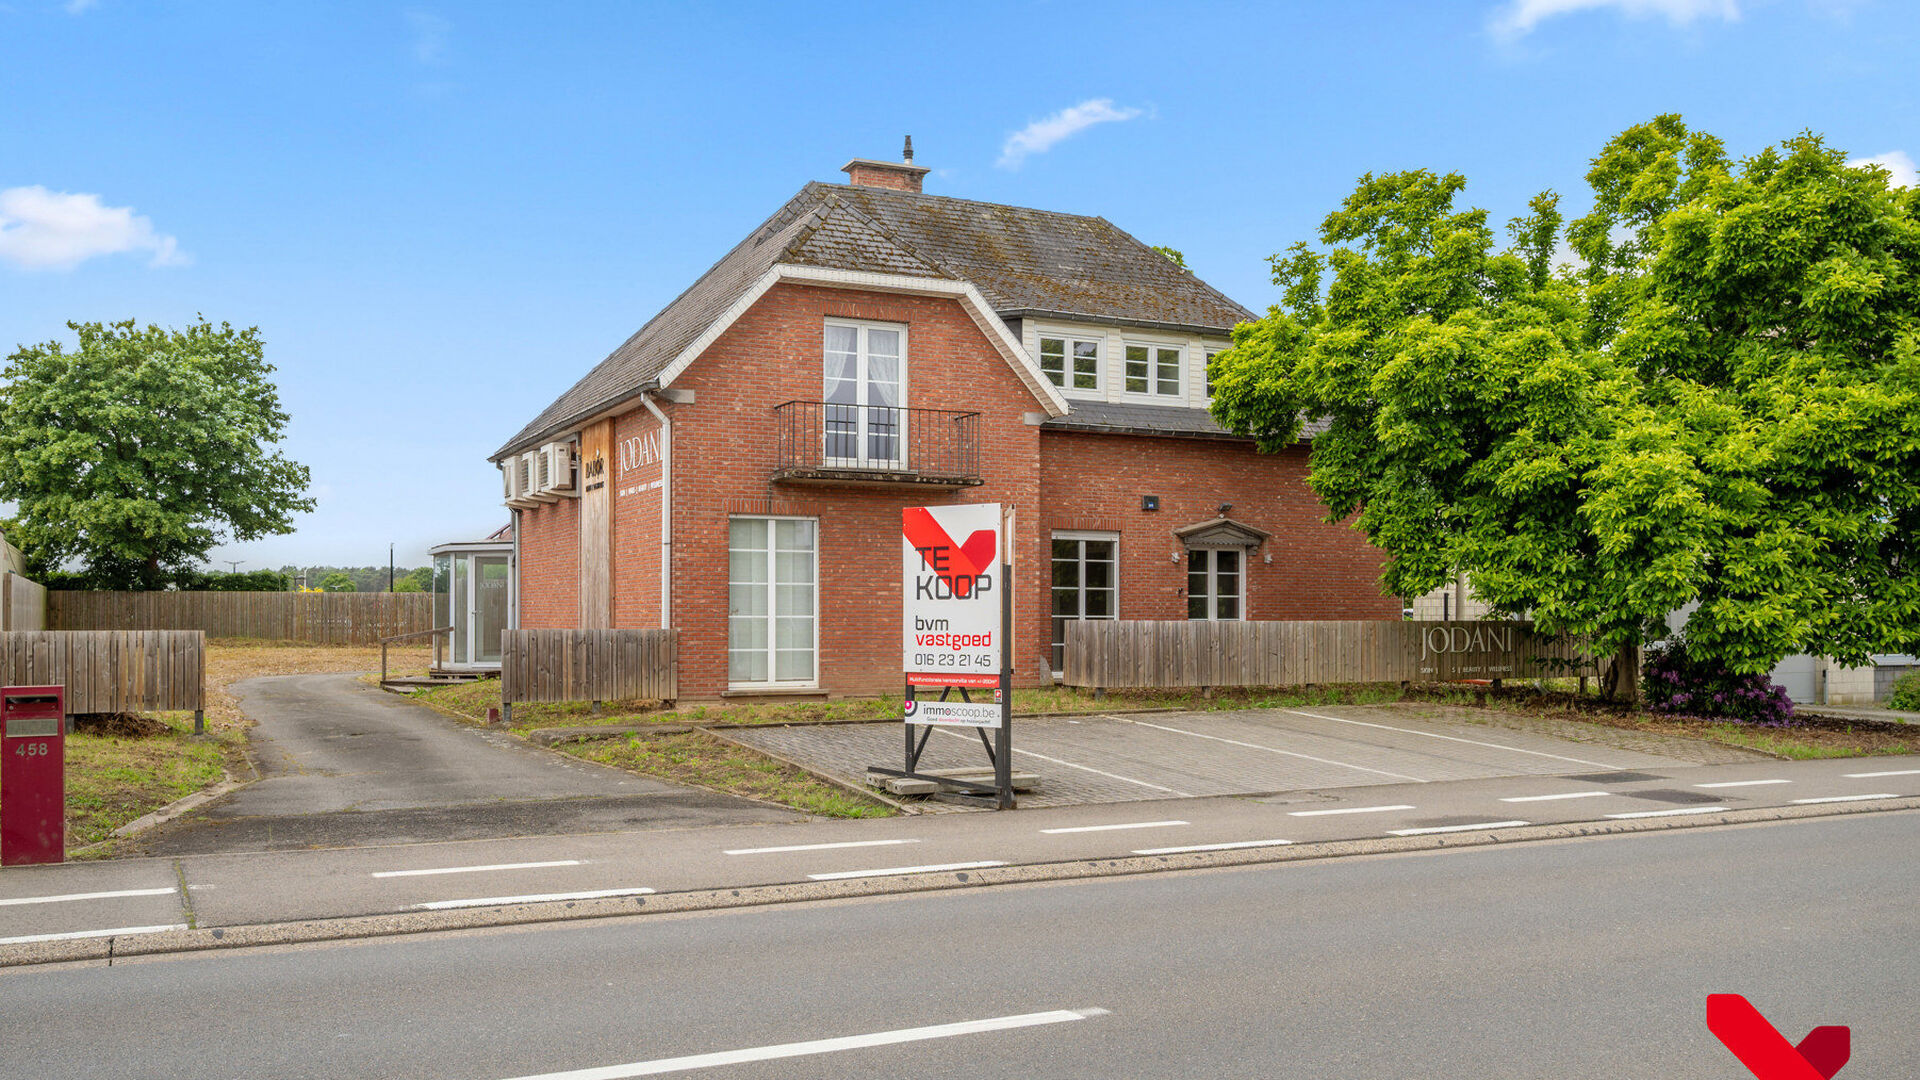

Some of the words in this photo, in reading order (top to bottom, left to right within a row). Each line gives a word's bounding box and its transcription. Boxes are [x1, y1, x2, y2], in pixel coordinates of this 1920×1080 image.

[915, 546, 950, 572] TE
[915, 574, 992, 600] KOOP
[915, 615, 949, 631] bvm
[915, 631, 992, 650] vastgoed
[1421, 626, 1512, 661] JODANI
[915, 653, 935, 666] 016
[938, 653, 955, 666] 23
[959, 654, 971, 667] 21
[974, 654, 991, 667] 45
[923, 705, 995, 718] immoscoop.be
[15, 743, 48, 756] 458
